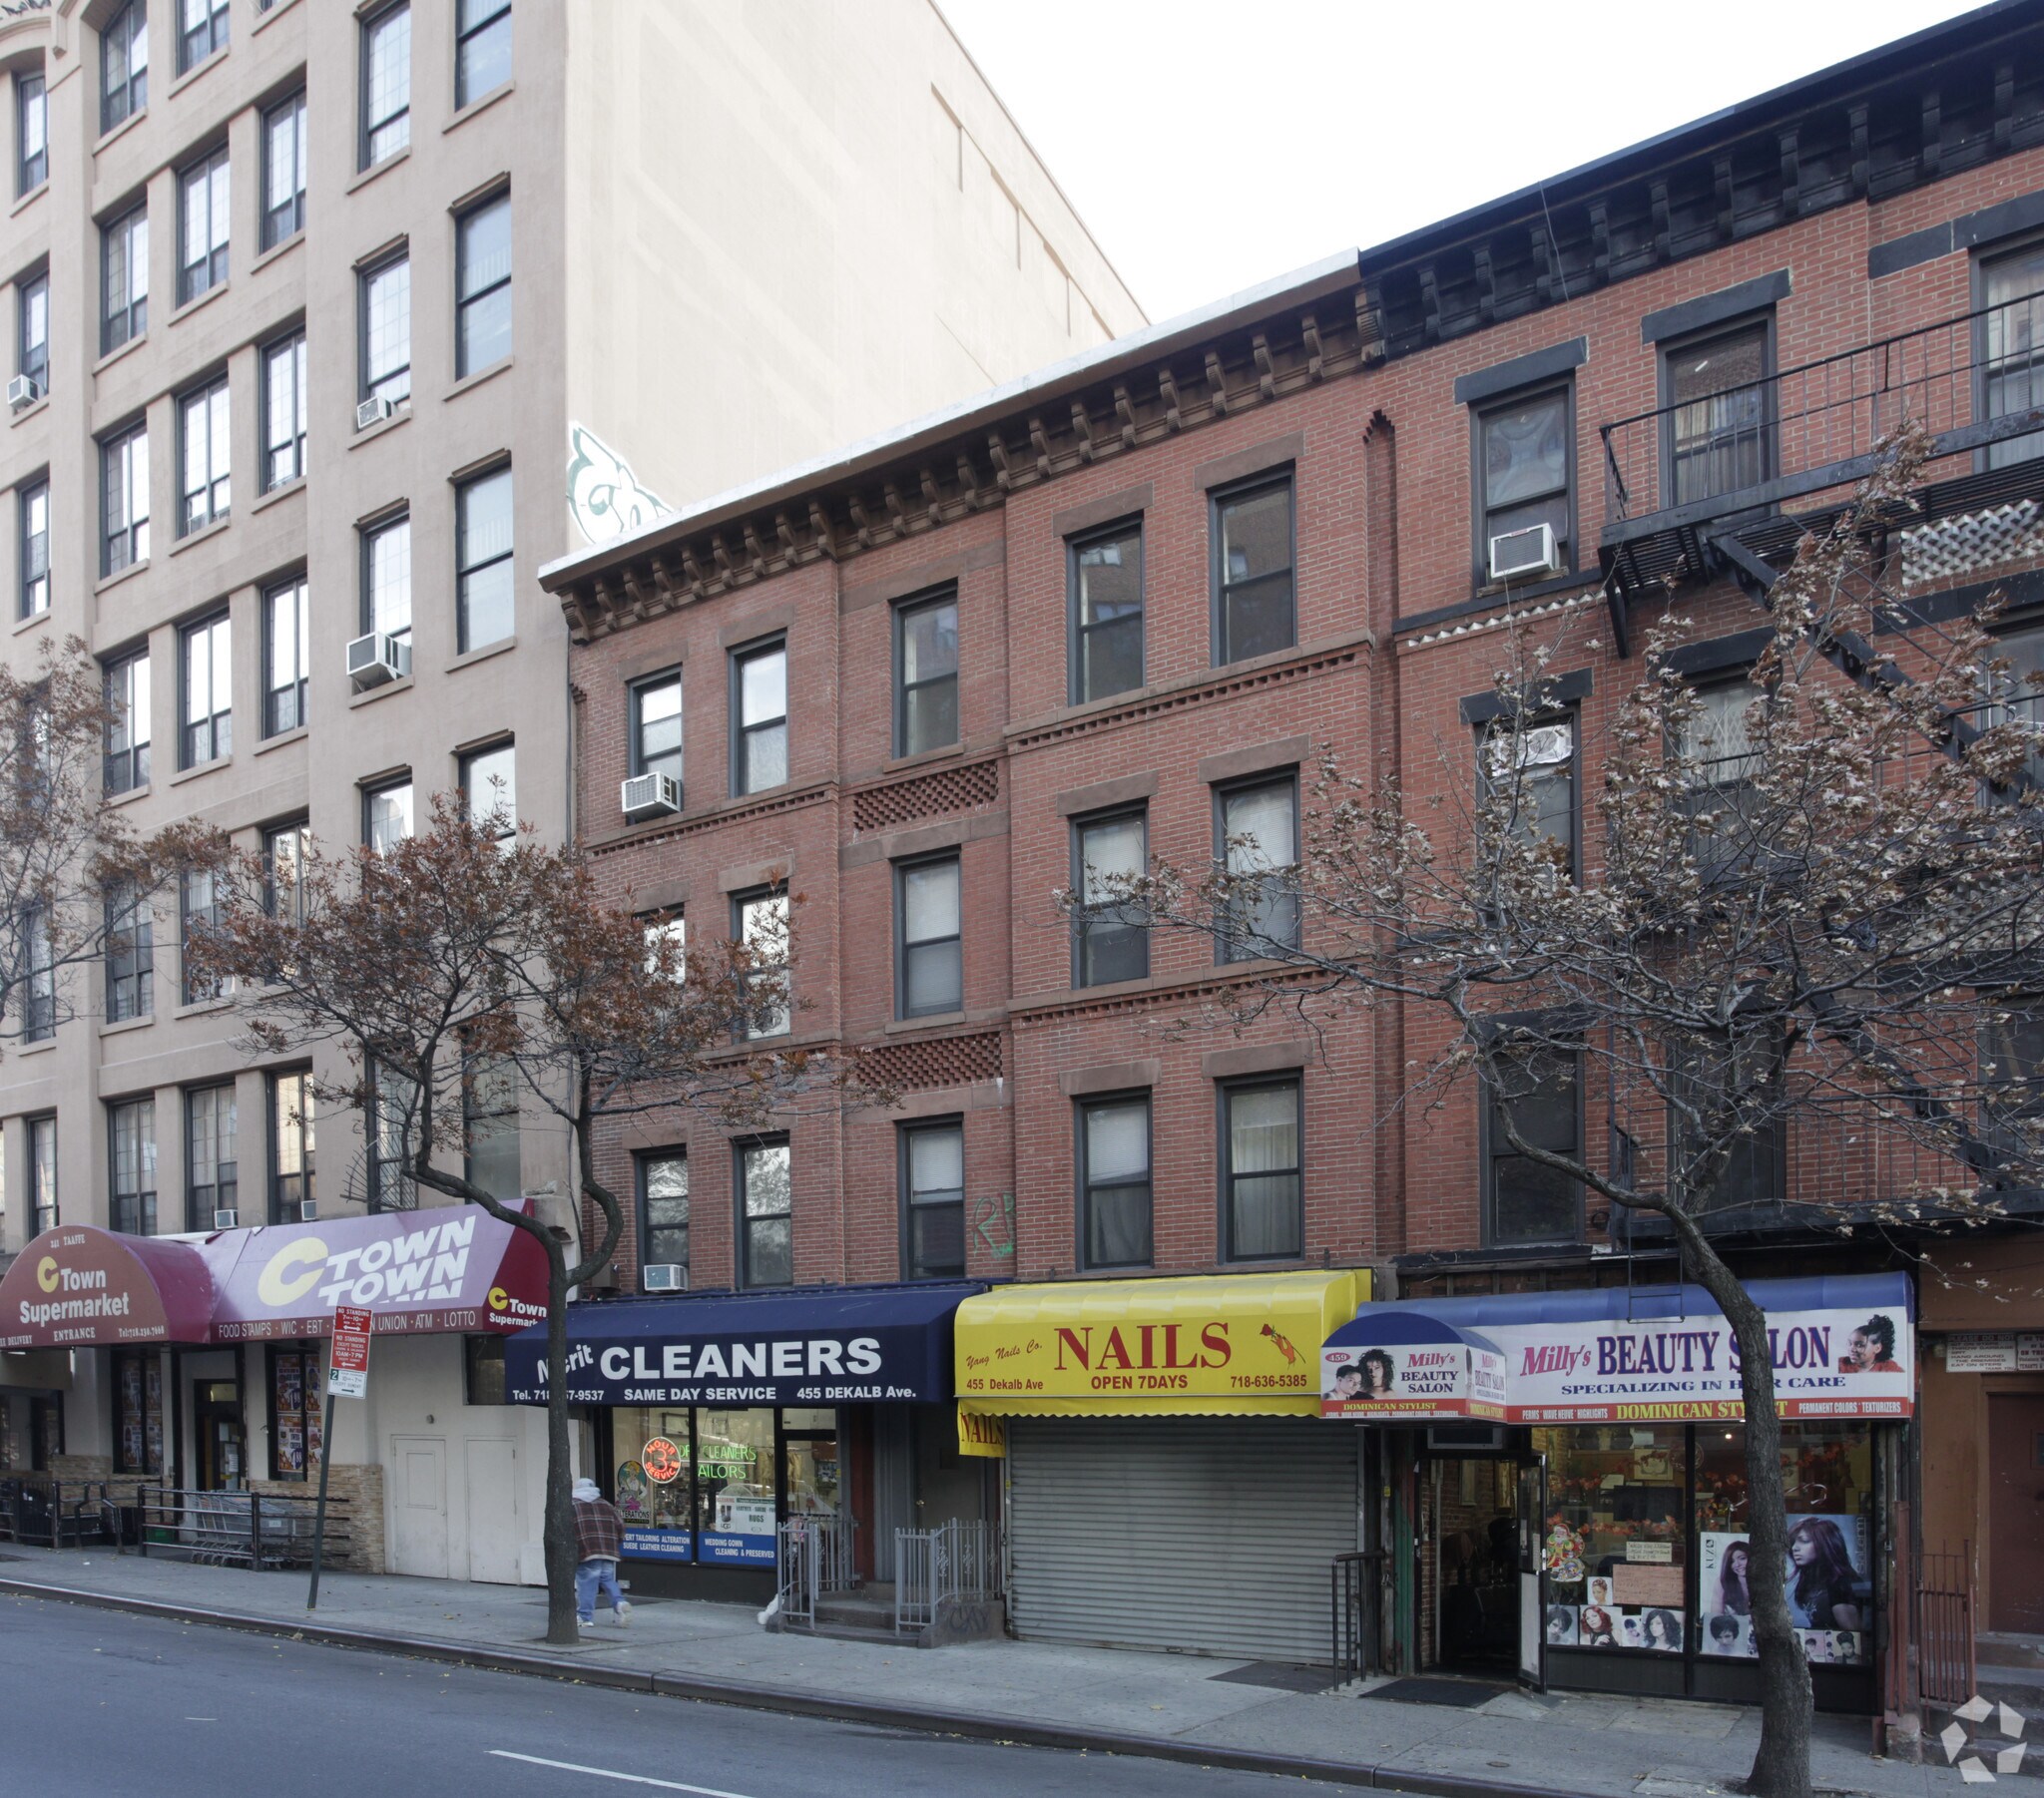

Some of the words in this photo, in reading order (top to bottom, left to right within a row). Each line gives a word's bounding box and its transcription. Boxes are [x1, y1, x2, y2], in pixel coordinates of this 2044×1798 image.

[64, 1234, 86, 1246] TAAFFE
[20, 1292, 129, 1327] Supermarket
[346, 1308, 369, 1317] STANDING
[219, 1323, 240, 1338] FOOD
[242, 1322, 271, 1337] STAMPS
[281, 1320, 296, 1335] WIC
[306, 1319, 323, 1334] EBT
[378, 1315, 407, 1330] UNION
[415, 1313, 433, 1329] ATM
[444, 1310, 476, 1327] LOTTO
[8, 1335, 32, 1346] DELIVERY
[54, 1327, 96, 1342] ENTRANCE
[996, 1345, 1021, 1359] Nails
[1026, 1339, 1043, 1354] Co.
[1054, 1322, 1232, 1371] NAILS
[1520, 1345, 1591, 1377] Milly's
[1597, 1332, 1720, 1375] BEAUTY
[1729, 1326, 1830, 1371] SLON
[600, 1337, 882, 1380] CLEANERS
[1407, 1352, 1455, 1368] Milly's
[1091, 1376, 1133, 1389] OPEN
[1138, 1375, 1188, 1389] 7DAYS
[1231, 1375, 1307, 1389] 718-636-5385
[1401, 1371, 1459, 1381] BEAUTY
[966, 1379, 984, 1390] 455
[990, 1378, 1023, 1390] Dekalb
[1025, 1379, 1044, 1390] Ave
[1408, 1383, 1453, 1393] SALON
[1561, 1381, 1695, 1395] SPECIALIZING
[1702, 1380, 1723, 1390] IN
[1788, 1377, 1846, 1389] CARE
[513, 1390, 531, 1401] Tel.
[624, 1388, 666, 1401] SAME
[671, 1387, 701, 1401] DAY
[705, 1387, 776, 1400] SERVICE
[796, 1387, 821, 1399] 455
[824, 1385, 882, 1399] DEKALB
[886, 1385, 916, 1398] Ave.
[1522, 1409, 1539, 1420] PERMS
[1543, 1409, 1557, 1419] WAVE
[1577, 1408, 1608, 1419] HIGHLIGHTS
[1617, 1403, 1713, 1420] DOMINICAN
[1798, 1402, 1834, 1413] PERMANENT
[1834, 1402, 1858, 1413] COLORS
[1861, 1401, 1900, 1413] TEXTURIZERS
[960, 1412, 1004, 1447] NAILS
[647, 1440, 676, 1455] HOUR
[702, 1445, 757, 1461] CLEANERS
[653, 1449, 667, 1473] 3
[645, 1461, 679, 1480] SERVICE
[699, 1465, 747, 1479] AILORS
[639, 1543, 661, 1552] LEATHER
[662, 1535, 691, 1545] ALTERATION
[746, 1549, 774, 1559] PRESERVED
